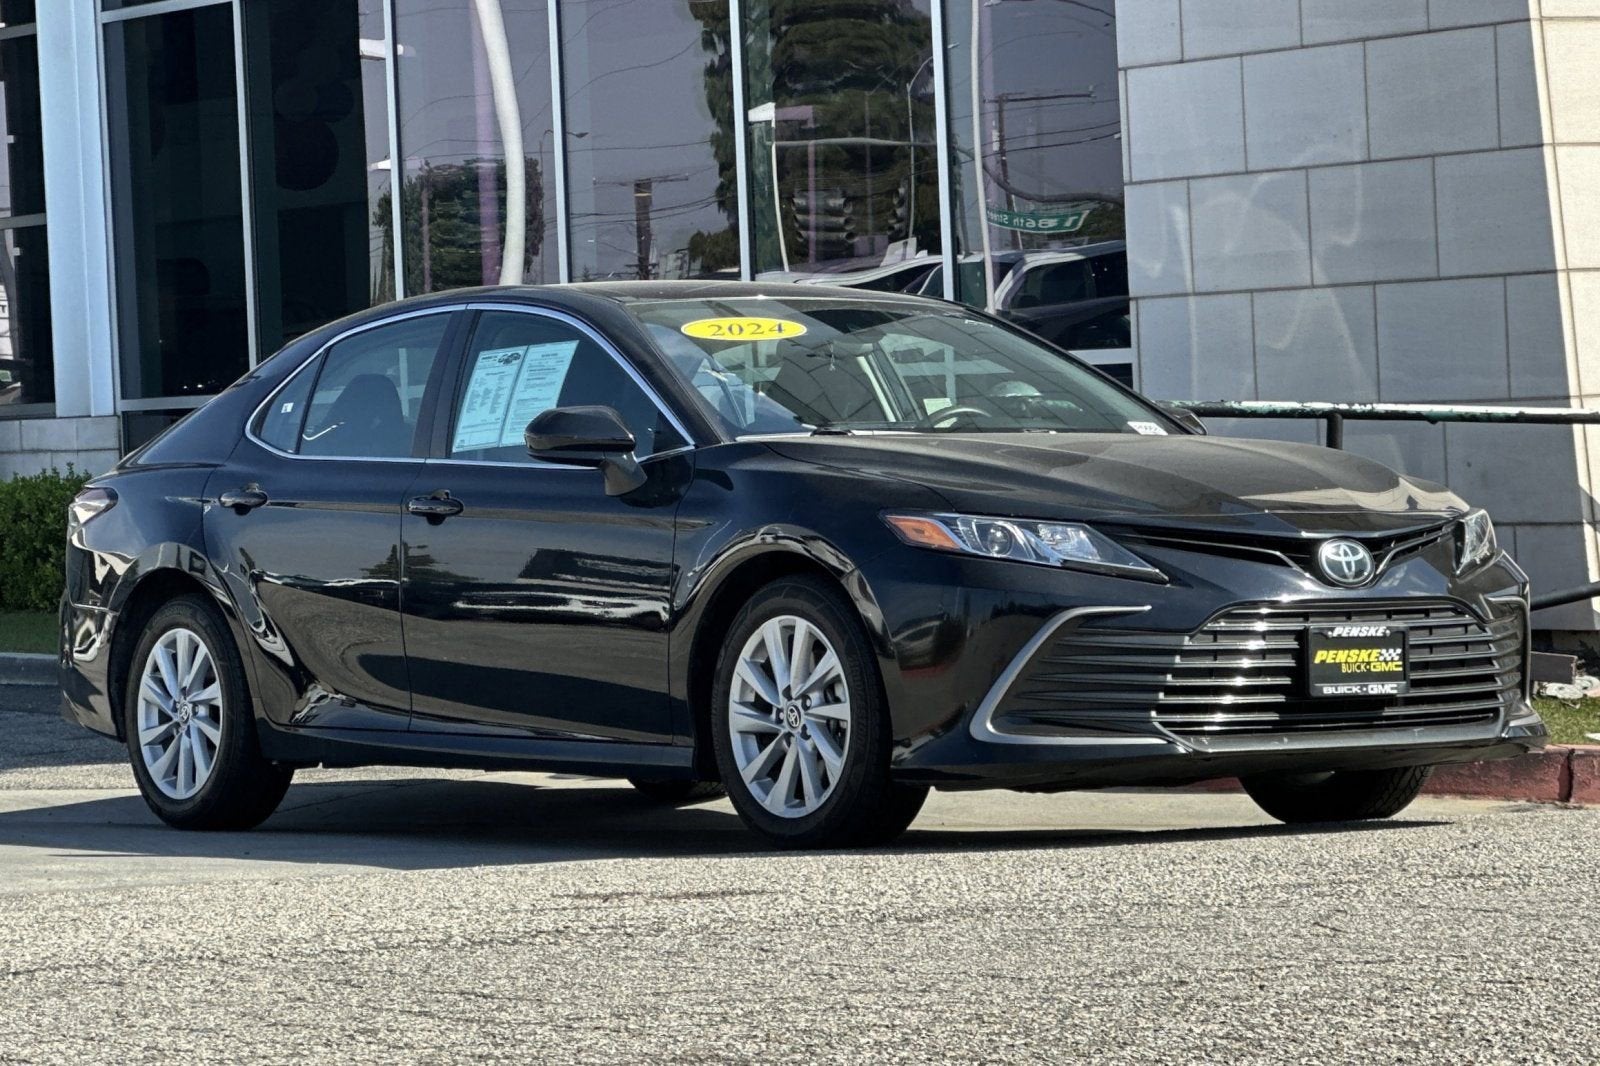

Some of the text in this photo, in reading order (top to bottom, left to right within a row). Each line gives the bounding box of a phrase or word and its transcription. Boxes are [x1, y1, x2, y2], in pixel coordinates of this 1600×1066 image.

[708, 323, 785, 336] 2024
[1332, 626, 1387, 637] PENSKE
[1314, 649, 1380, 664] PENSKE
[1341, 661, 1403, 673] BUICK GMC
[1323, 684, 1398, 694] BUICK GMC
